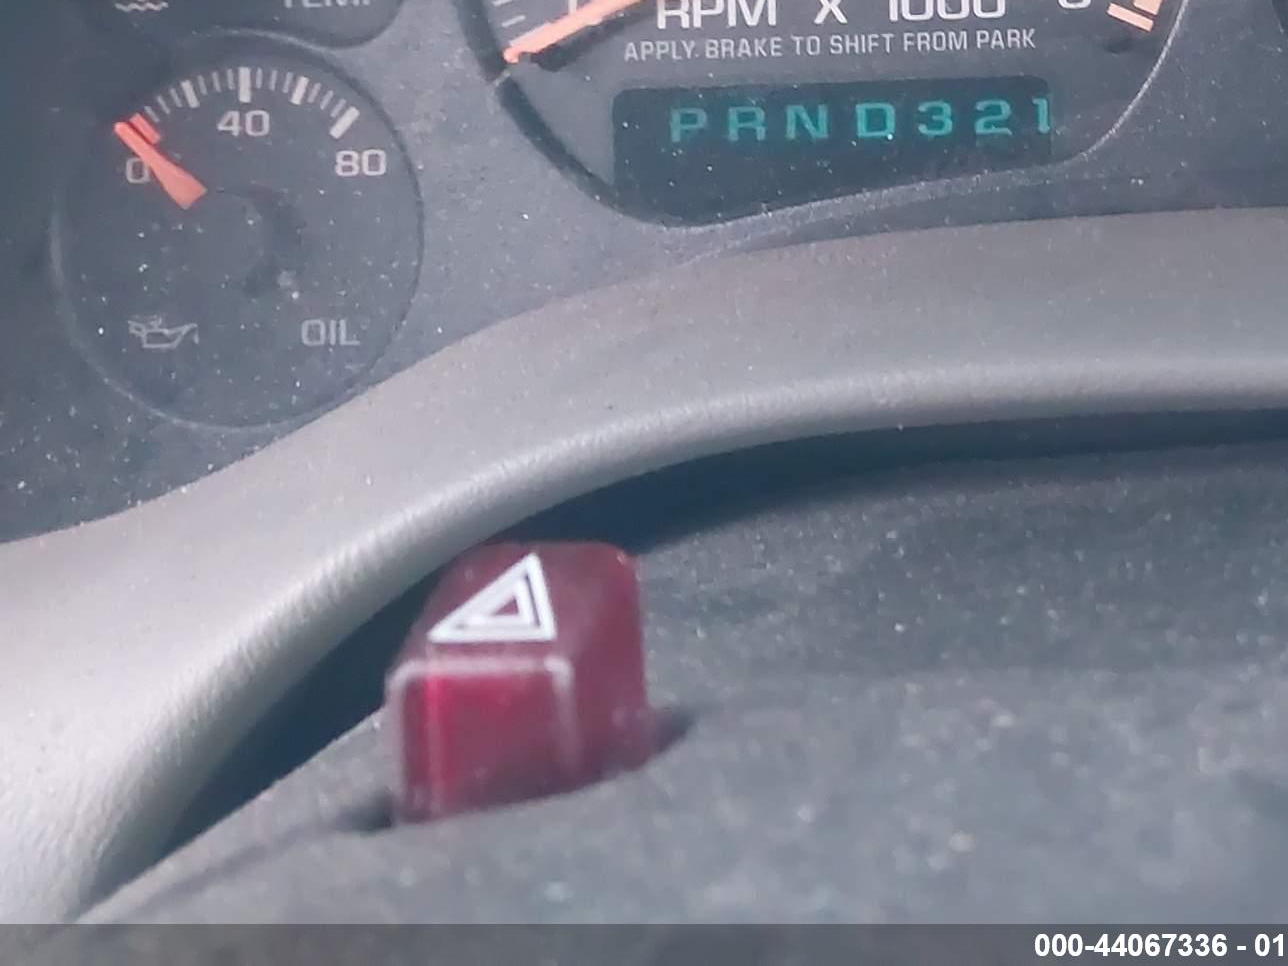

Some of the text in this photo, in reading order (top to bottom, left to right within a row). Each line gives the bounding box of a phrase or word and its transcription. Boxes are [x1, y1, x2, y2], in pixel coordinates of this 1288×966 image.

[624, 27, 1036, 62] APPLY BRAKE TO SHIFT FROM PARK
[216, 110, 271, 137] 40
[125, 157, 152, 185] 0
[334, 150, 387, 177] 80
[301, 318, 360, 347] OIL
